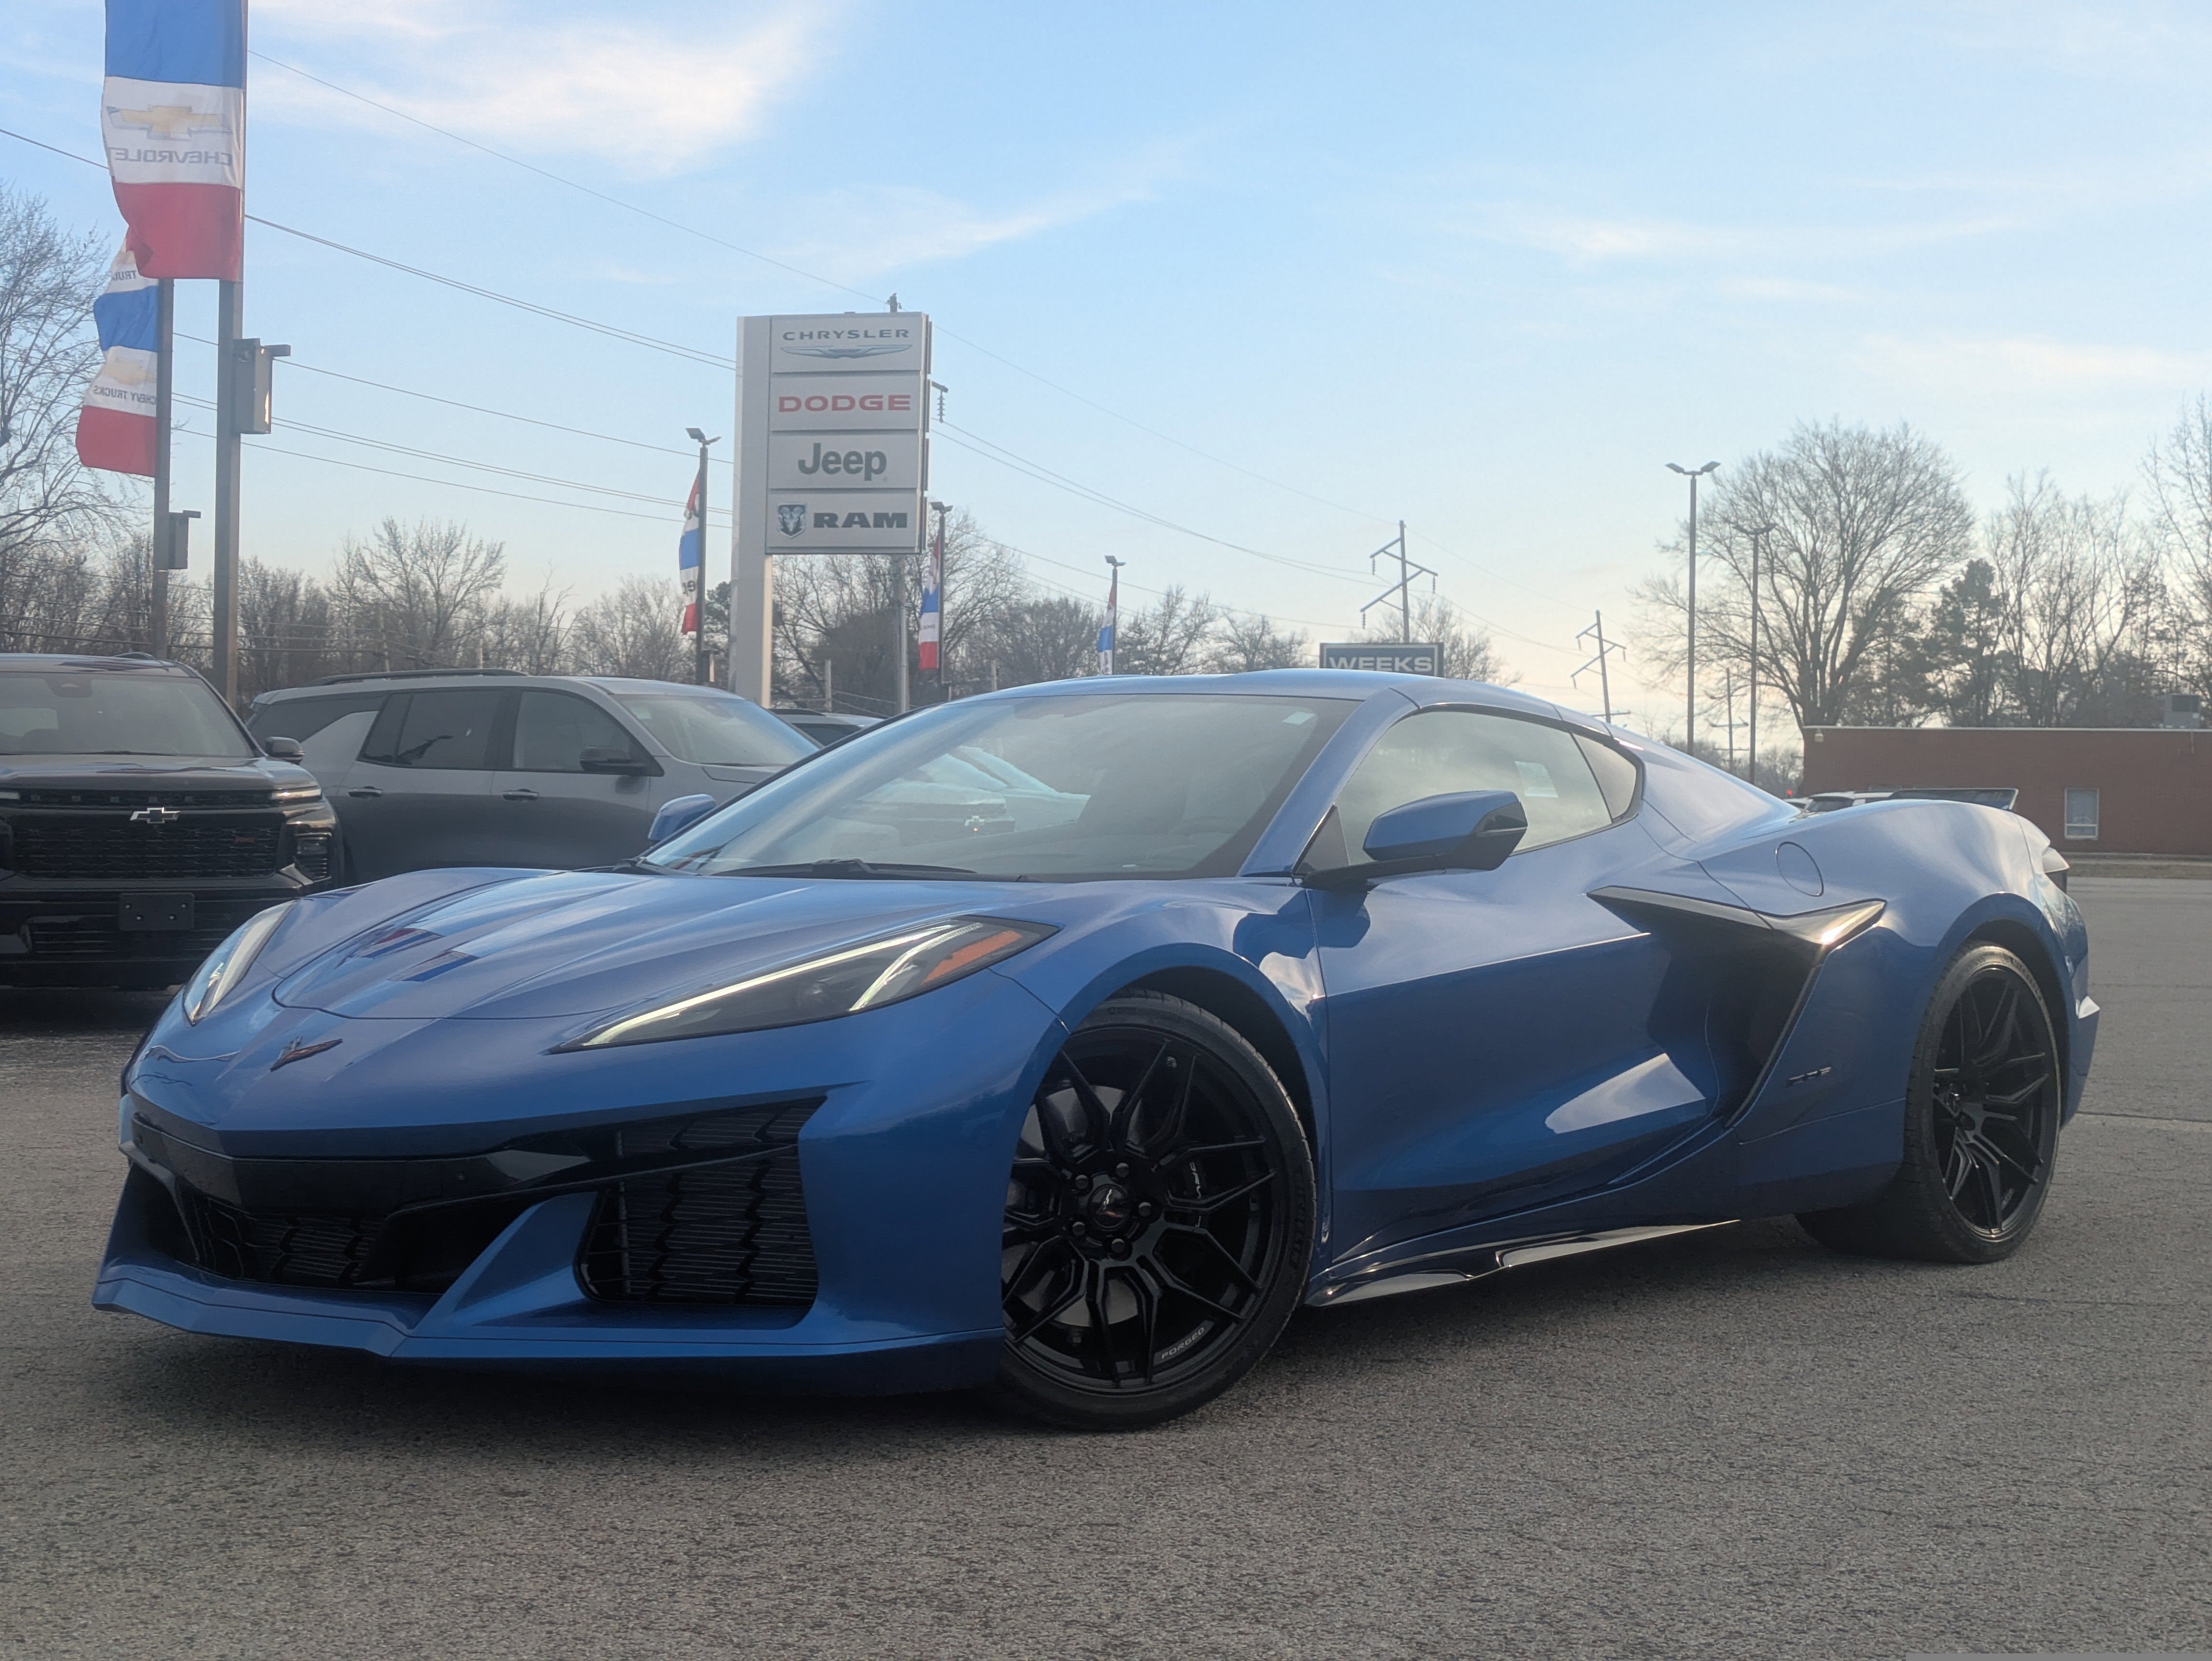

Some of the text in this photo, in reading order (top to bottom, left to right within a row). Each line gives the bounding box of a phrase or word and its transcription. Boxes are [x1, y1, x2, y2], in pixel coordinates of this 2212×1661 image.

[783, 329, 909, 341] CHRYSLER
[779, 395, 911, 412] DODGE
[798, 443, 886, 481] Jeep
[814, 512, 907, 528] RAM
[1329, 656, 1432, 672] WEEKS
